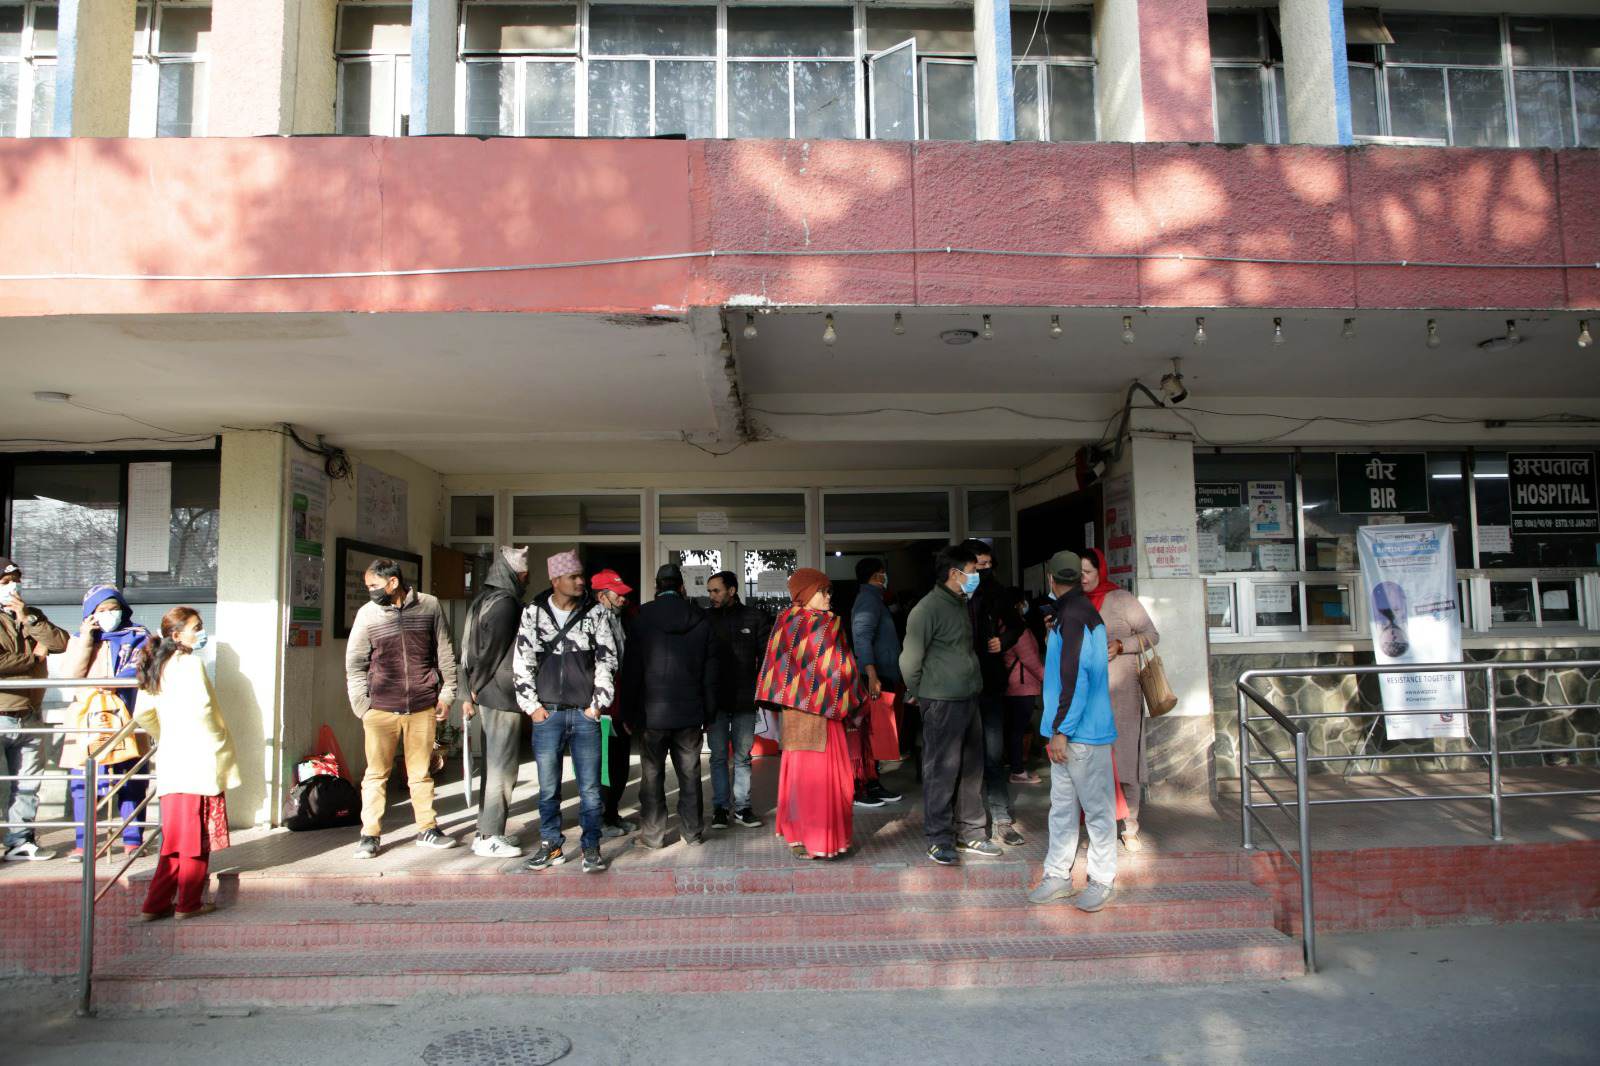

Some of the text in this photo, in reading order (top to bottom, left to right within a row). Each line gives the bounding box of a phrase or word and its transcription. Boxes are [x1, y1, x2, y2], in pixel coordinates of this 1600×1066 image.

[1365, 458, 1397, 480] वीर
[1513, 458, 1590, 476] अस्पताल
[1370, 487, 1397, 509] BIR
[1517, 483, 1590, 505] HOSPITAL
[1386, 674, 1456, 684] RESISTANCE TOGETHER
